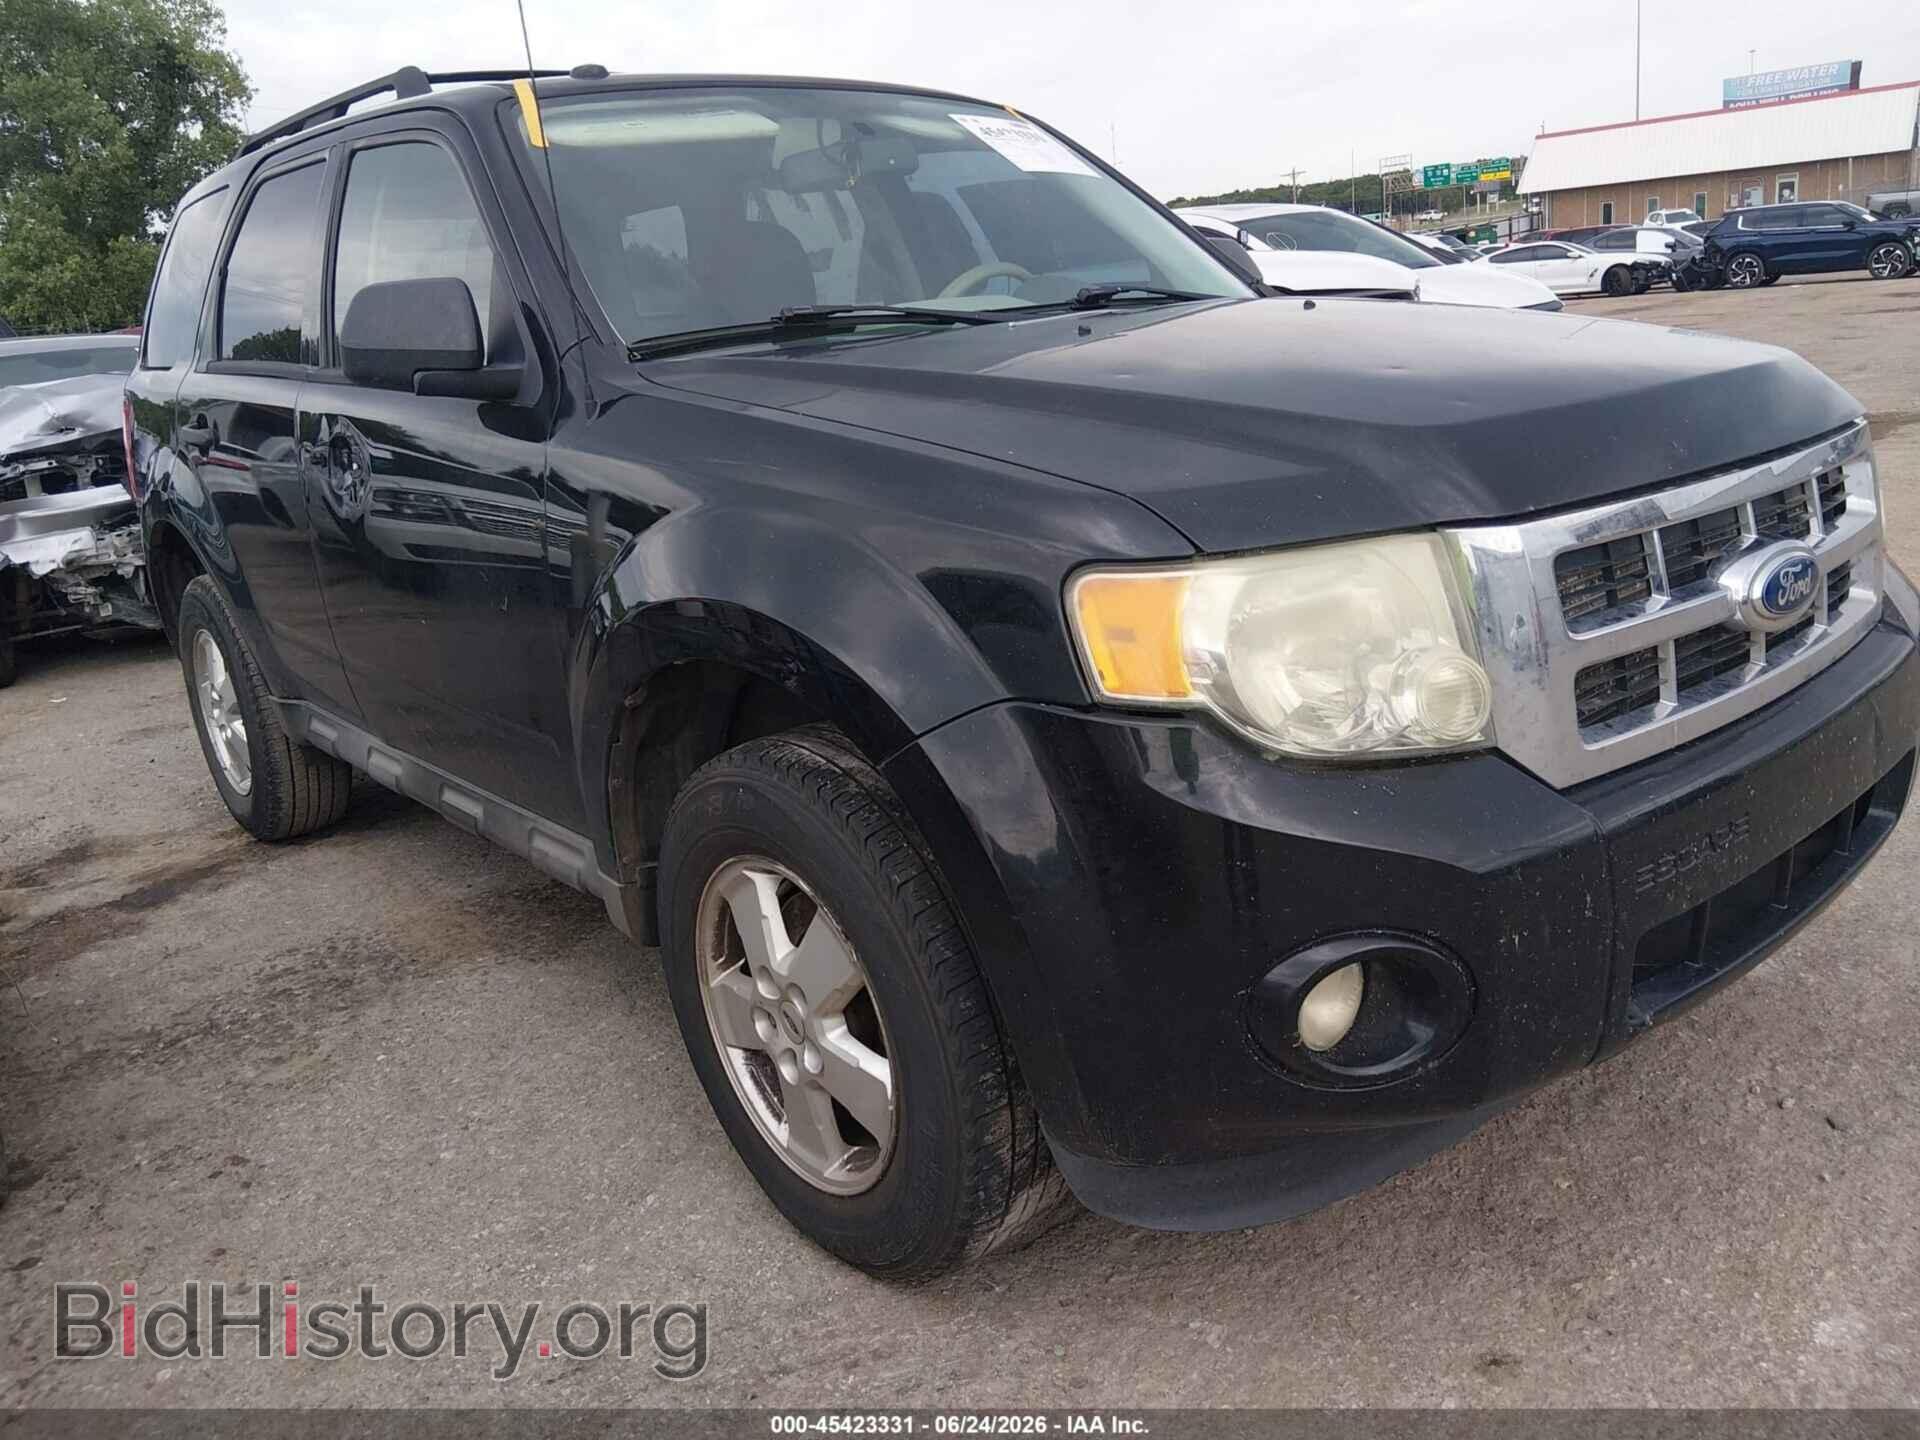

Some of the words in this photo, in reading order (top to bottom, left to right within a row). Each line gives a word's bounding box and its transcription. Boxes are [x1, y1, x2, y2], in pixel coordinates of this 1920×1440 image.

[1746, 72, 1785, 88] FREE
[1788, 63, 1840, 82] WATER
[1777, 563, 1812, 606] Ford
